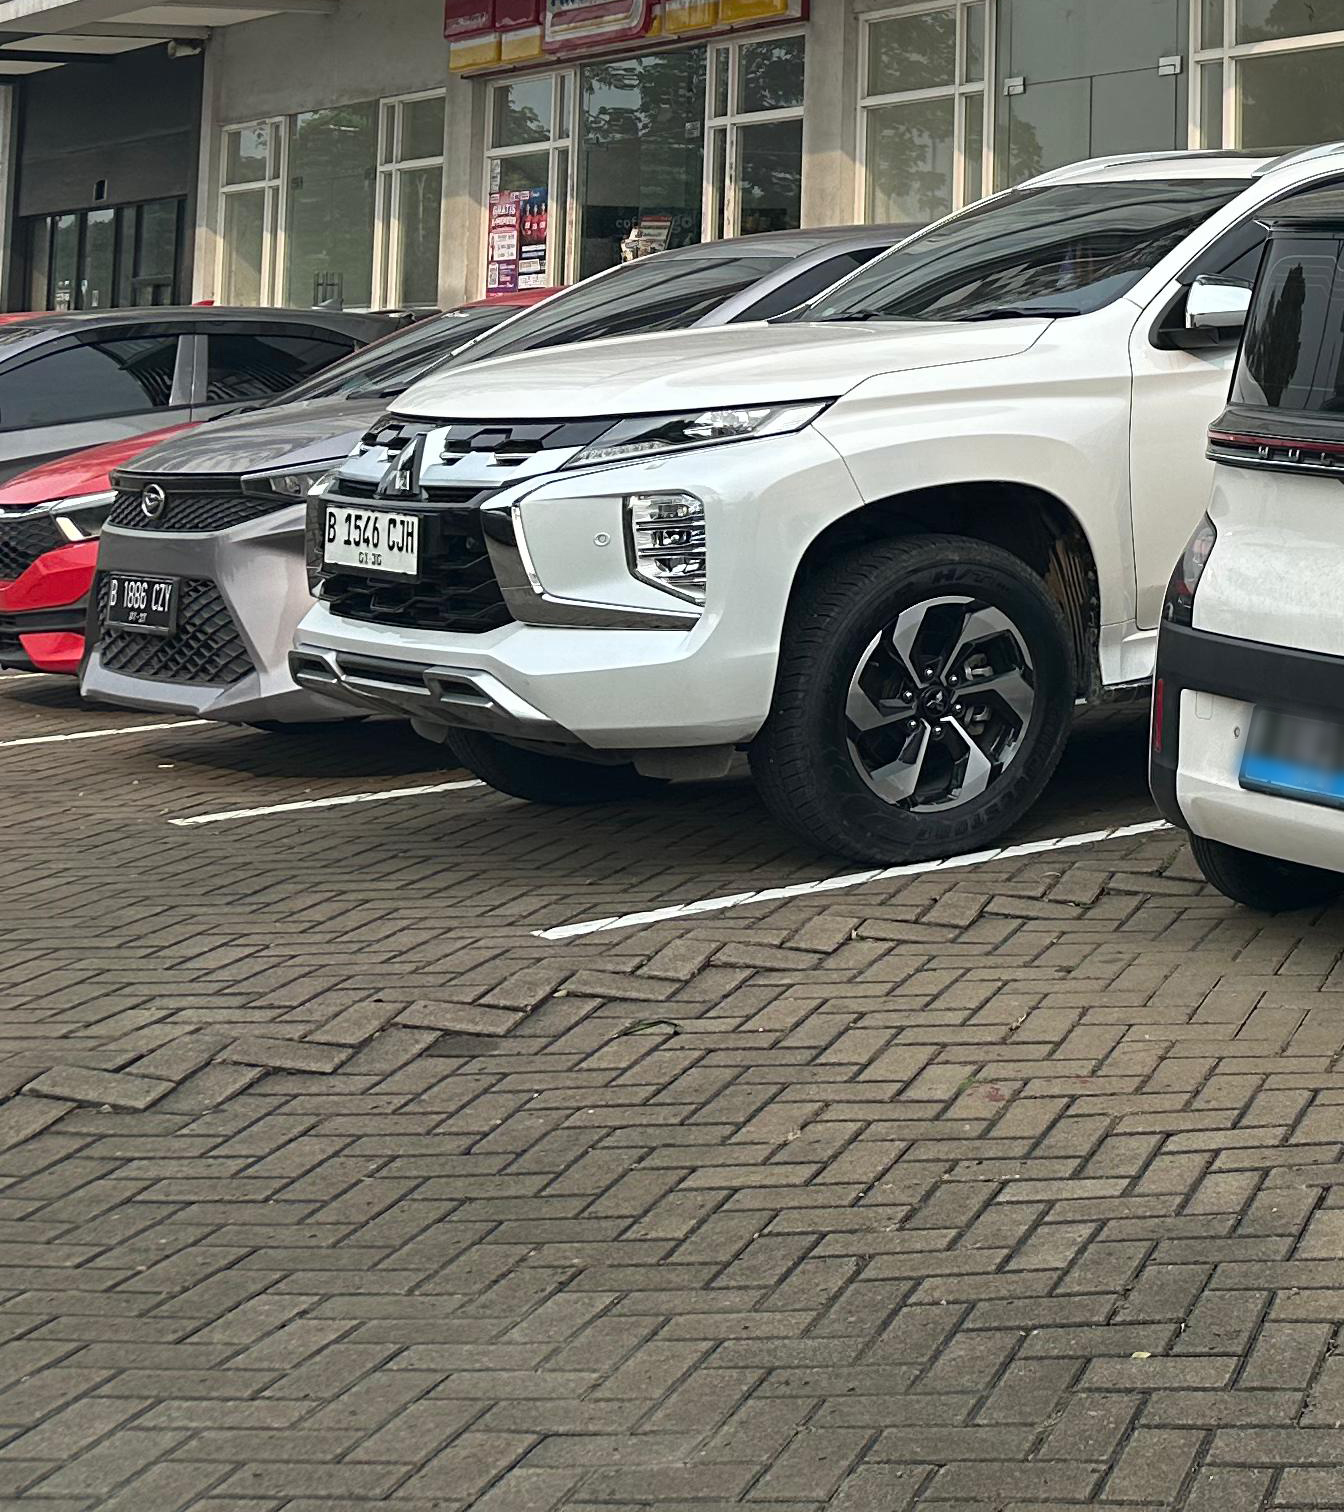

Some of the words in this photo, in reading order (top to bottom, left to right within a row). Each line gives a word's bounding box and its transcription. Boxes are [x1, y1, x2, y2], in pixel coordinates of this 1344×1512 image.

[327, 511, 337, 543] B
[343, 512, 380, 548] 1546
[387, 517, 415, 555] CJH
[110, 579, 119, 606] B
[123, 580, 149, 609] 1886
[151, 583, 173, 612] CZY
